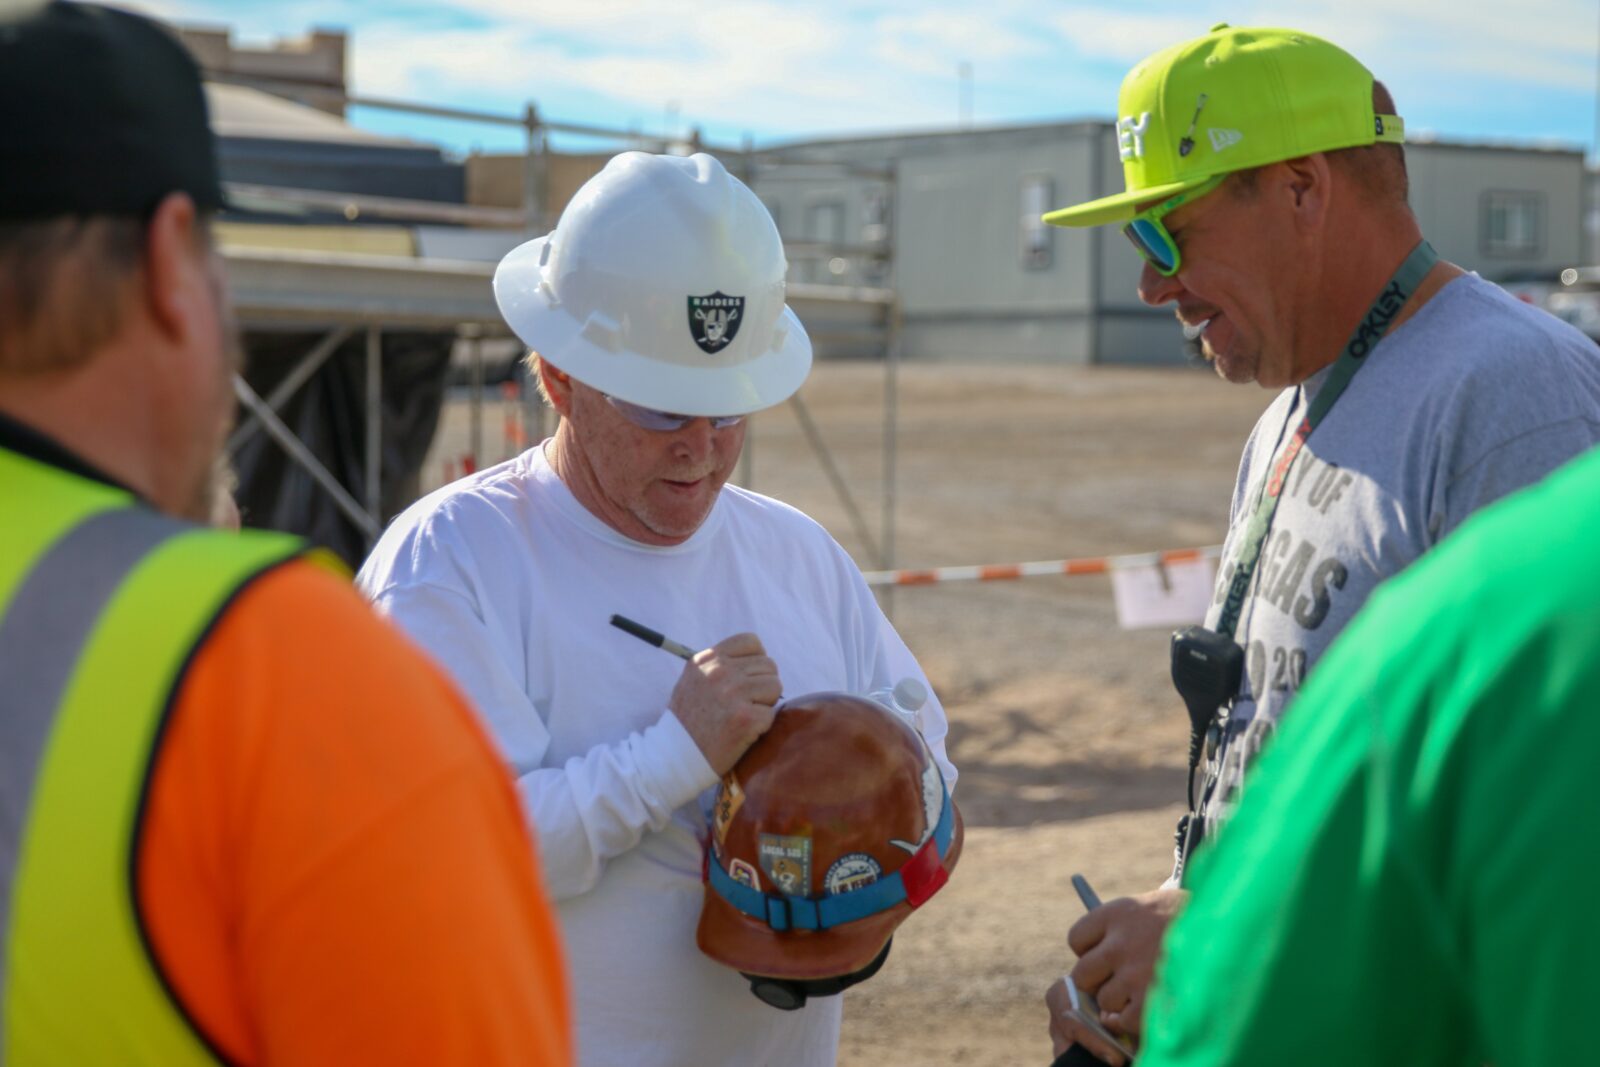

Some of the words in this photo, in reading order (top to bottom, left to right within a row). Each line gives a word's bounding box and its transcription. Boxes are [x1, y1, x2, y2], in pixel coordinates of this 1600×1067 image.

[693, 297, 741, 307] RAIDERS
[1348, 280, 1407, 359] OAKLEY
[1307, 462, 1354, 516] OF
[761, 844, 785, 857] LOCAL
